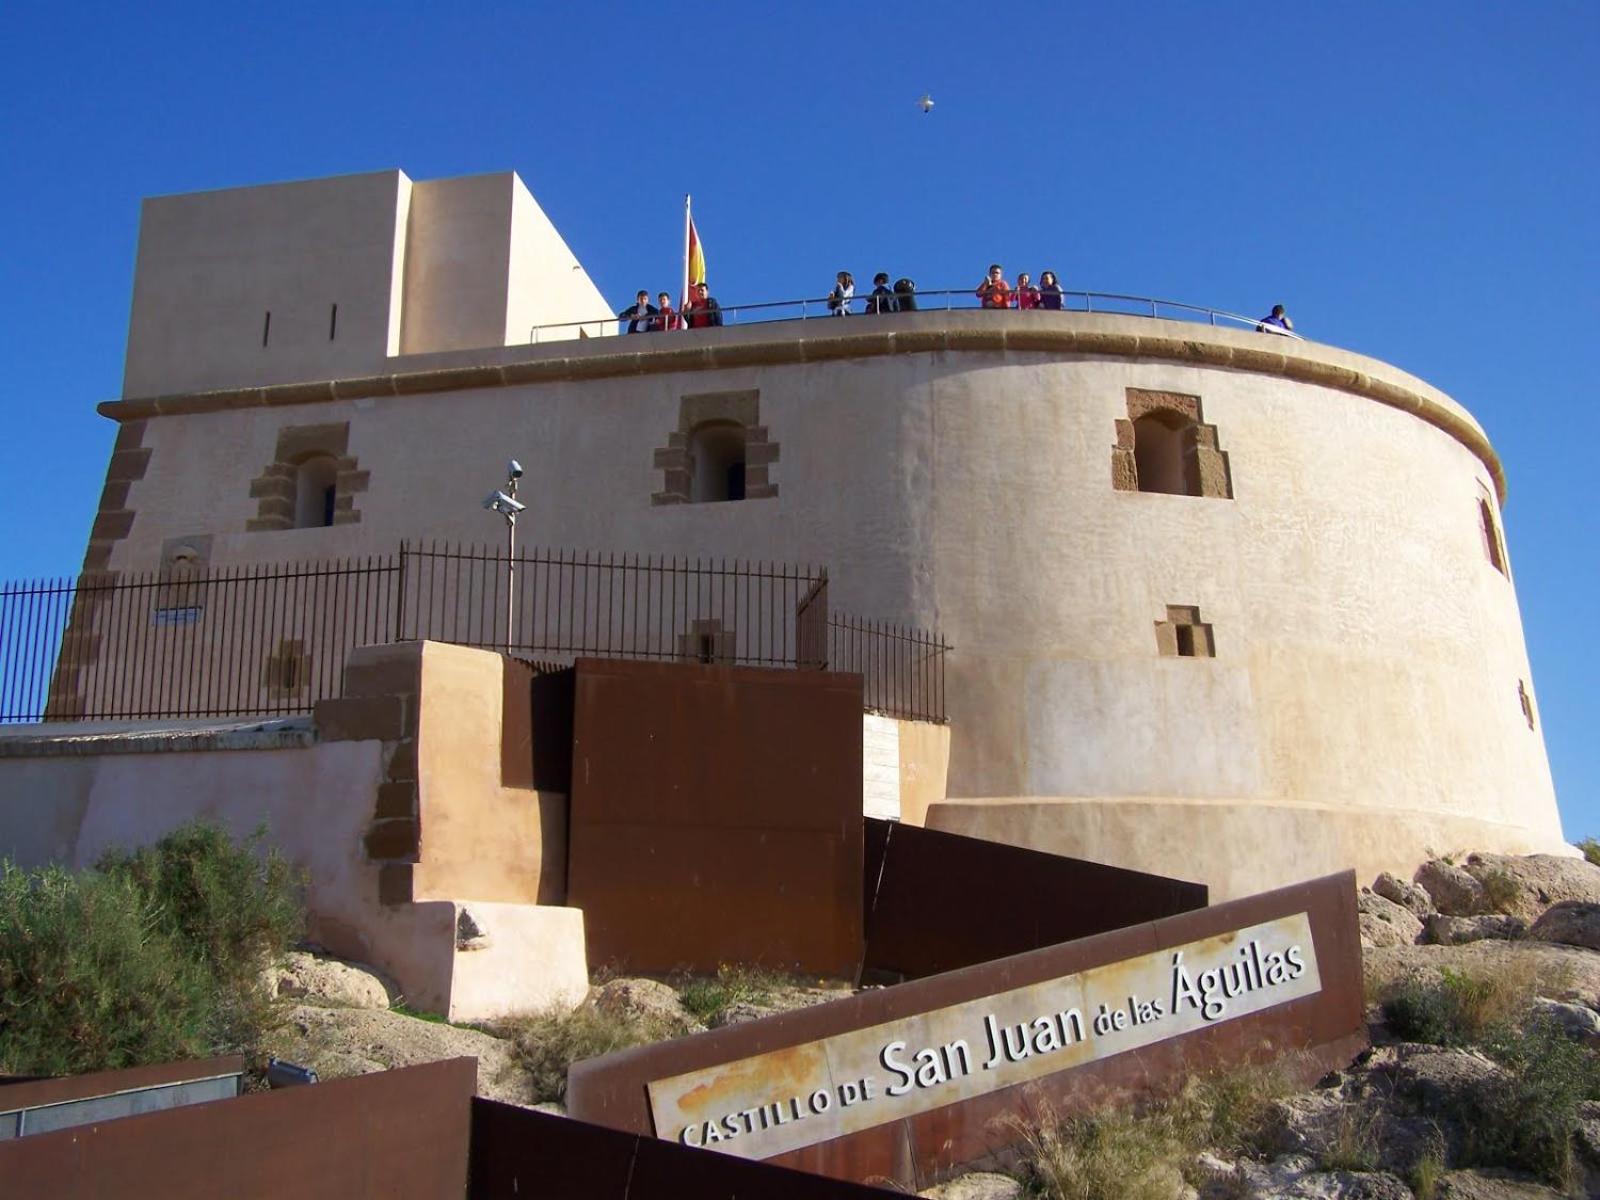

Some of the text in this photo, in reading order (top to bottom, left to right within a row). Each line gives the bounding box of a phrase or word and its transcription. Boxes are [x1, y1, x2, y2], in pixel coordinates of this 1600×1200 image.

[681, 939, 1305, 1148] CASTILLO DE San Juan de las Águilas
